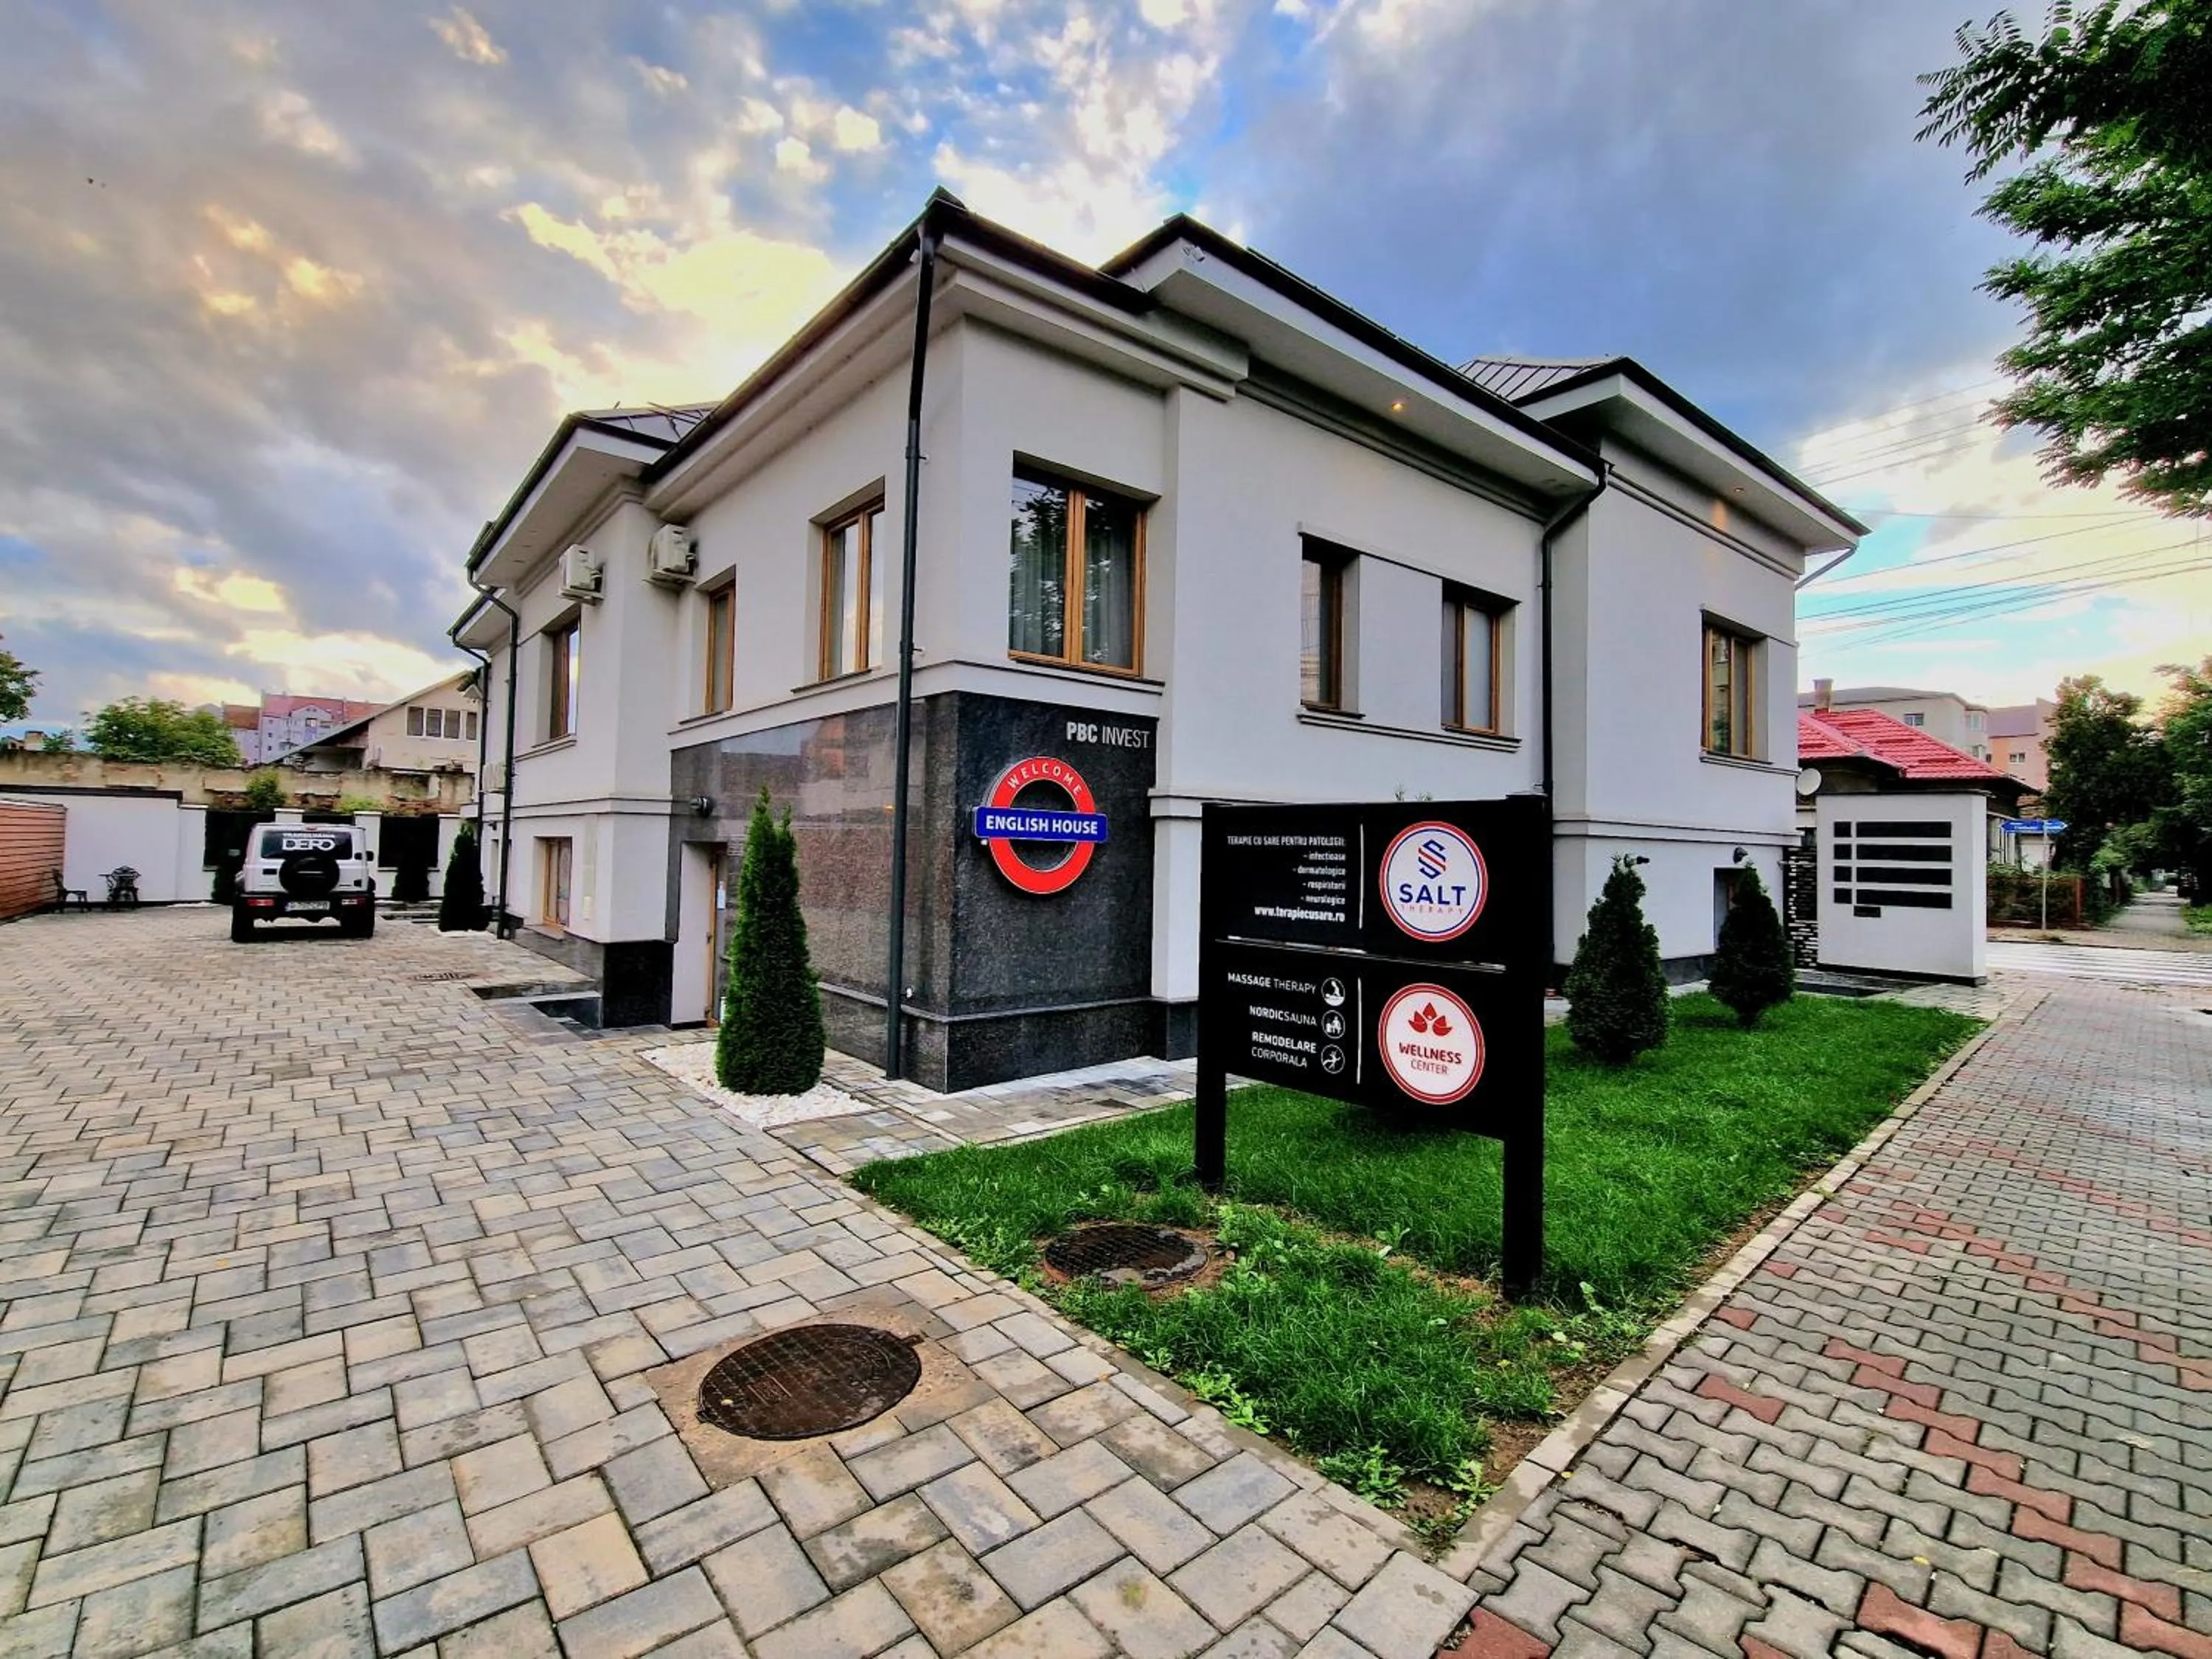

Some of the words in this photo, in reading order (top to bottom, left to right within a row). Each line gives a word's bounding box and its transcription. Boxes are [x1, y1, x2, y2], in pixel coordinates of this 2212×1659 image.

[1066, 721, 1097, 743] PBC
[1102, 726, 1150, 748] INVEST
[1007, 762, 1082, 795] WELCOME
[986, 815, 1049, 832] ENGLISH
[1052, 819, 1098, 835] HOUSE
[1399, 883, 1467, 906] SALT
[1401, 905, 1464, 914] THERAPY
[1228, 973, 1271, 988] MASSAGE
[1273, 978, 1316, 995] THERAPY
[1252, 1032, 1317, 1054] REMODELARE
[1399, 1042, 1462, 1065] WELLNESS
[1251, 1046, 1307, 1068] CORPORALA
[1411, 1058, 1448, 1074] CENTER
